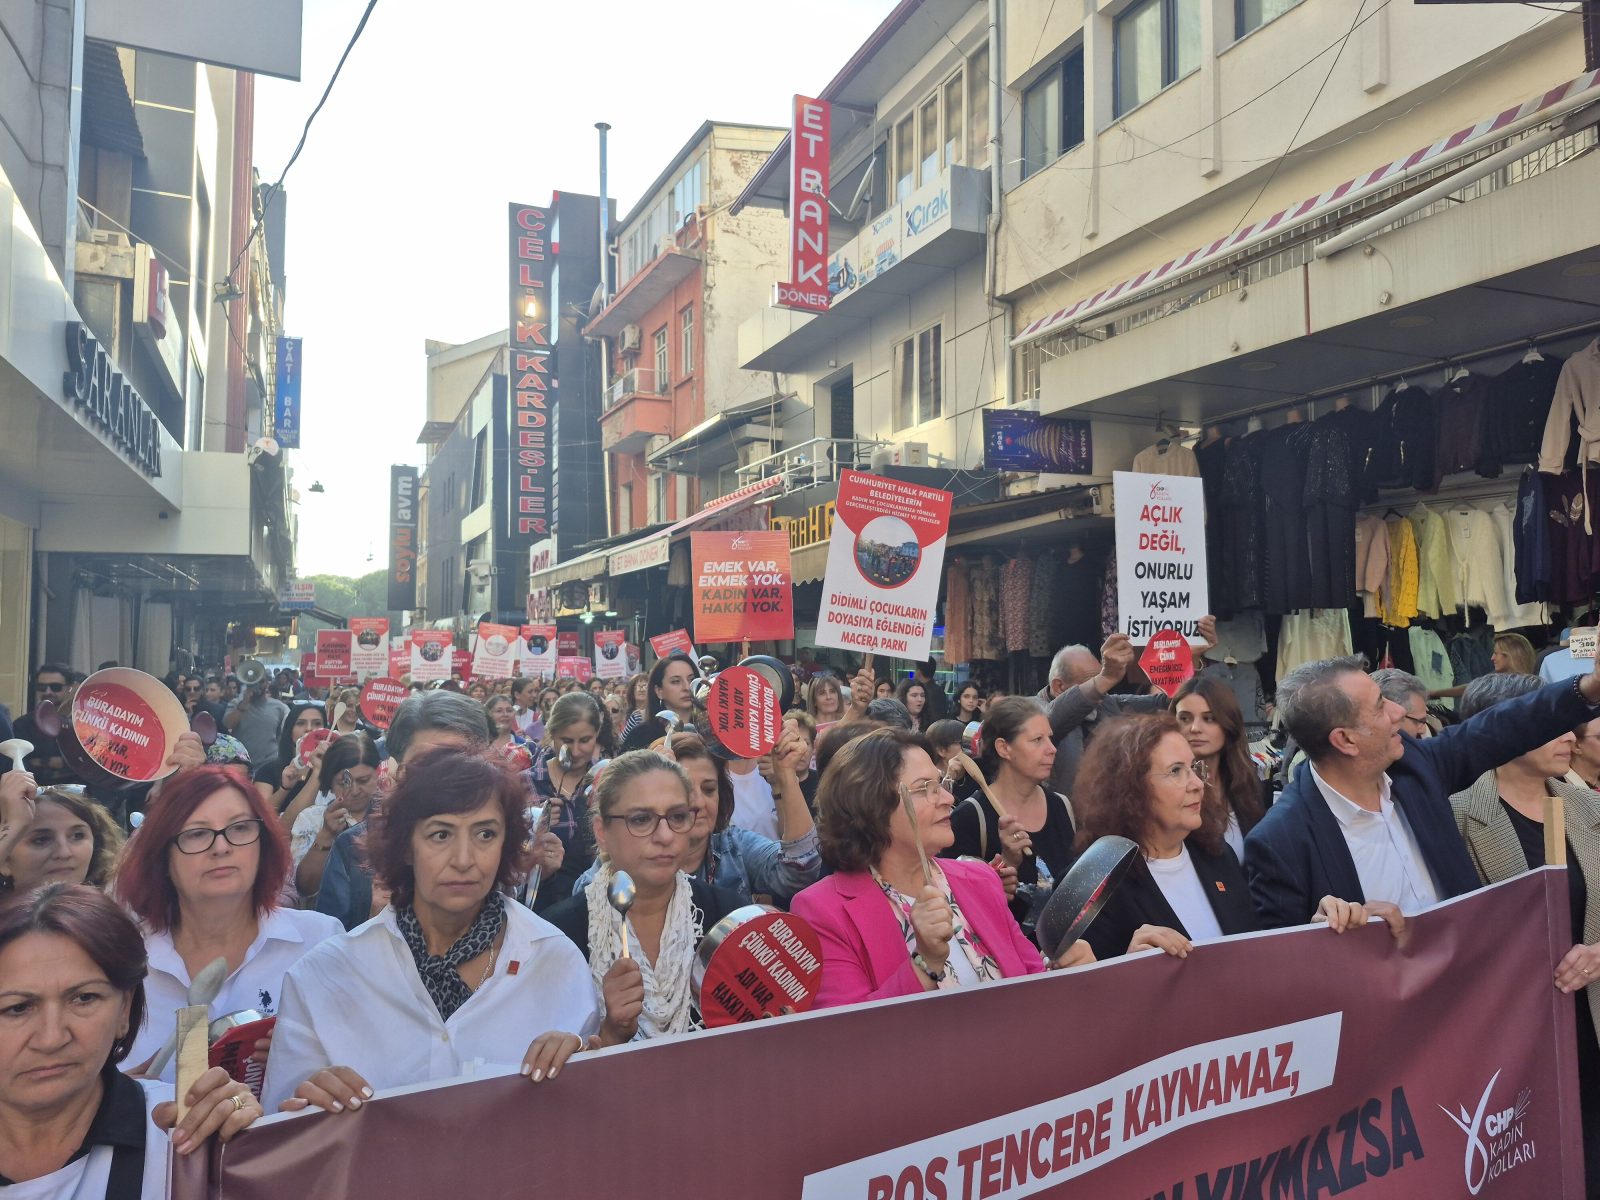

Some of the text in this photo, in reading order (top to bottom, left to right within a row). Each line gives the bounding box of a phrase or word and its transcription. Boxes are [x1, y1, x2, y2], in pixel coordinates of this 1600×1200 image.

[797, 103, 824, 286] ET BANK
[778, 288, 828, 306] DÖNER
[284, 396, 292, 428] BAR
[398, 476, 412, 521] avm
[849, 474, 944, 502] CUMHURİYET HALK PARTİLİ
[870, 489, 922, 508] BELEDİYELERİN
[1140, 504, 1183, 527] AÇLIK
[1138, 530, 1186, 554] DEĞİL,
[698, 574, 786, 588] EKMEK YOK.
[703, 561, 744, 574] EMEK
[1134, 561, 1193, 580] ONURLU
[702, 588, 748, 600] KADIN
[702, 601, 784, 614] HAKKI YOK.
[830, 591, 928, 621] DİDİMLİ ÇOCUKLARIN
[1140, 591, 1190, 613] YAŞAM
[828, 611, 926, 638] DOYASIYA EĞLENDİĞİ
[840, 632, 908, 652] MACERA PARKI
[366, 691, 386, 702] ÇÜNKÜ
[372, 682, 404, 694] BURADAYIM
[718, 678, 729, 710] HAKKI
[86, 696, 144, 728] BURADAYIM
[734, 688, 744, 729] ADI VAR,
[746, 673, 760, 750] ÇÜNKÜ KADININ
[763, 686, 774, 744] BURADAYIM
[108, 722, 150, 748] KADININ
[768, 918, 820, 974] BURADAYIM
[738, 930, 810, 1003] ÇÜNKÜ KADININ
[712, 982, 759, 1023] HAKKI YO
[734, 968, 774, 1011] ADI VAR,
[958, 1097, 1114, 1200] TENCERE
[1122, 1040, 1300, 1142] KAYNAMAZ,
[1485, 1107, 1515, 1137] CHP
[1489, 1122, 1524, 1162] KADIN
[1488, 1140, 1536, 1184] KOLLARI
